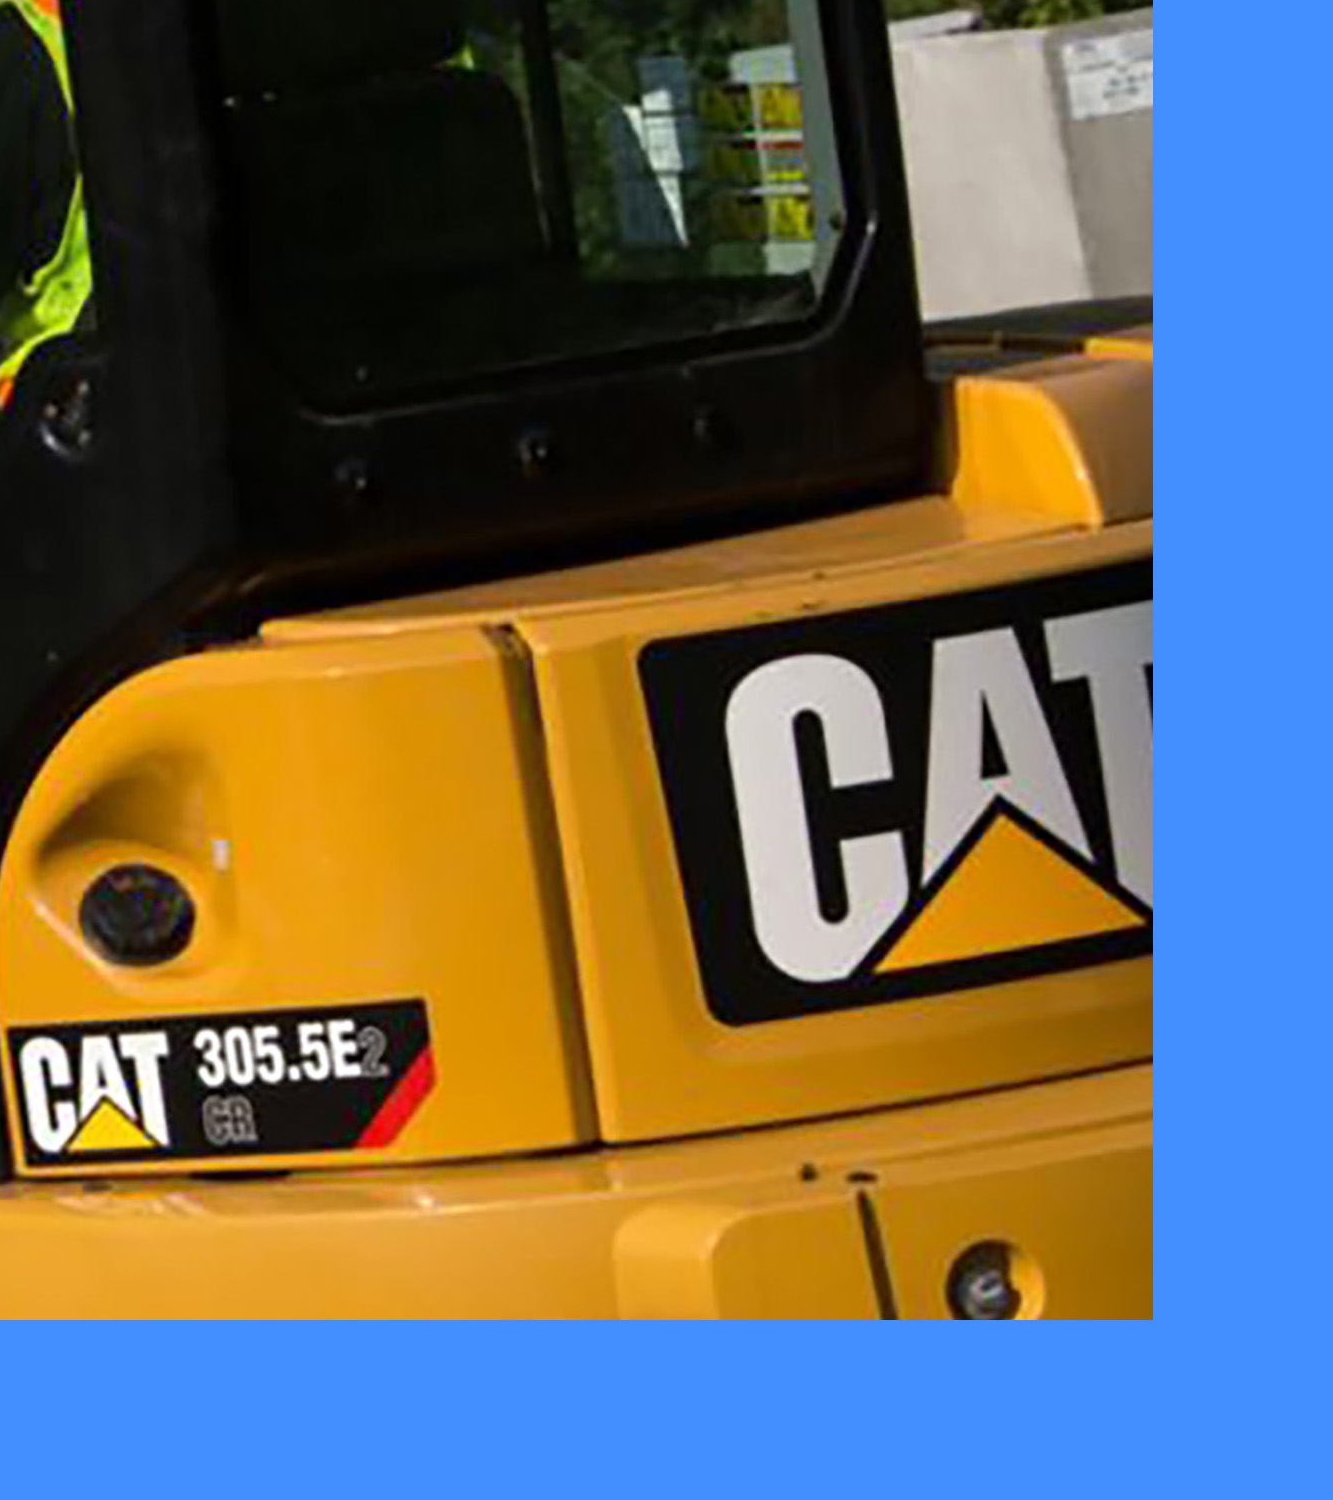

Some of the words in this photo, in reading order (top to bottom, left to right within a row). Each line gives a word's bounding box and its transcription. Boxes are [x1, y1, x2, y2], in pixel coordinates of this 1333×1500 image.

[724, 599, 1153, 984] CAT
[18, 1030, 171, 1154] CAT
[192, 1017, 391, 1089] 305.5E2
[201, 1094, 259, 1146] CR
